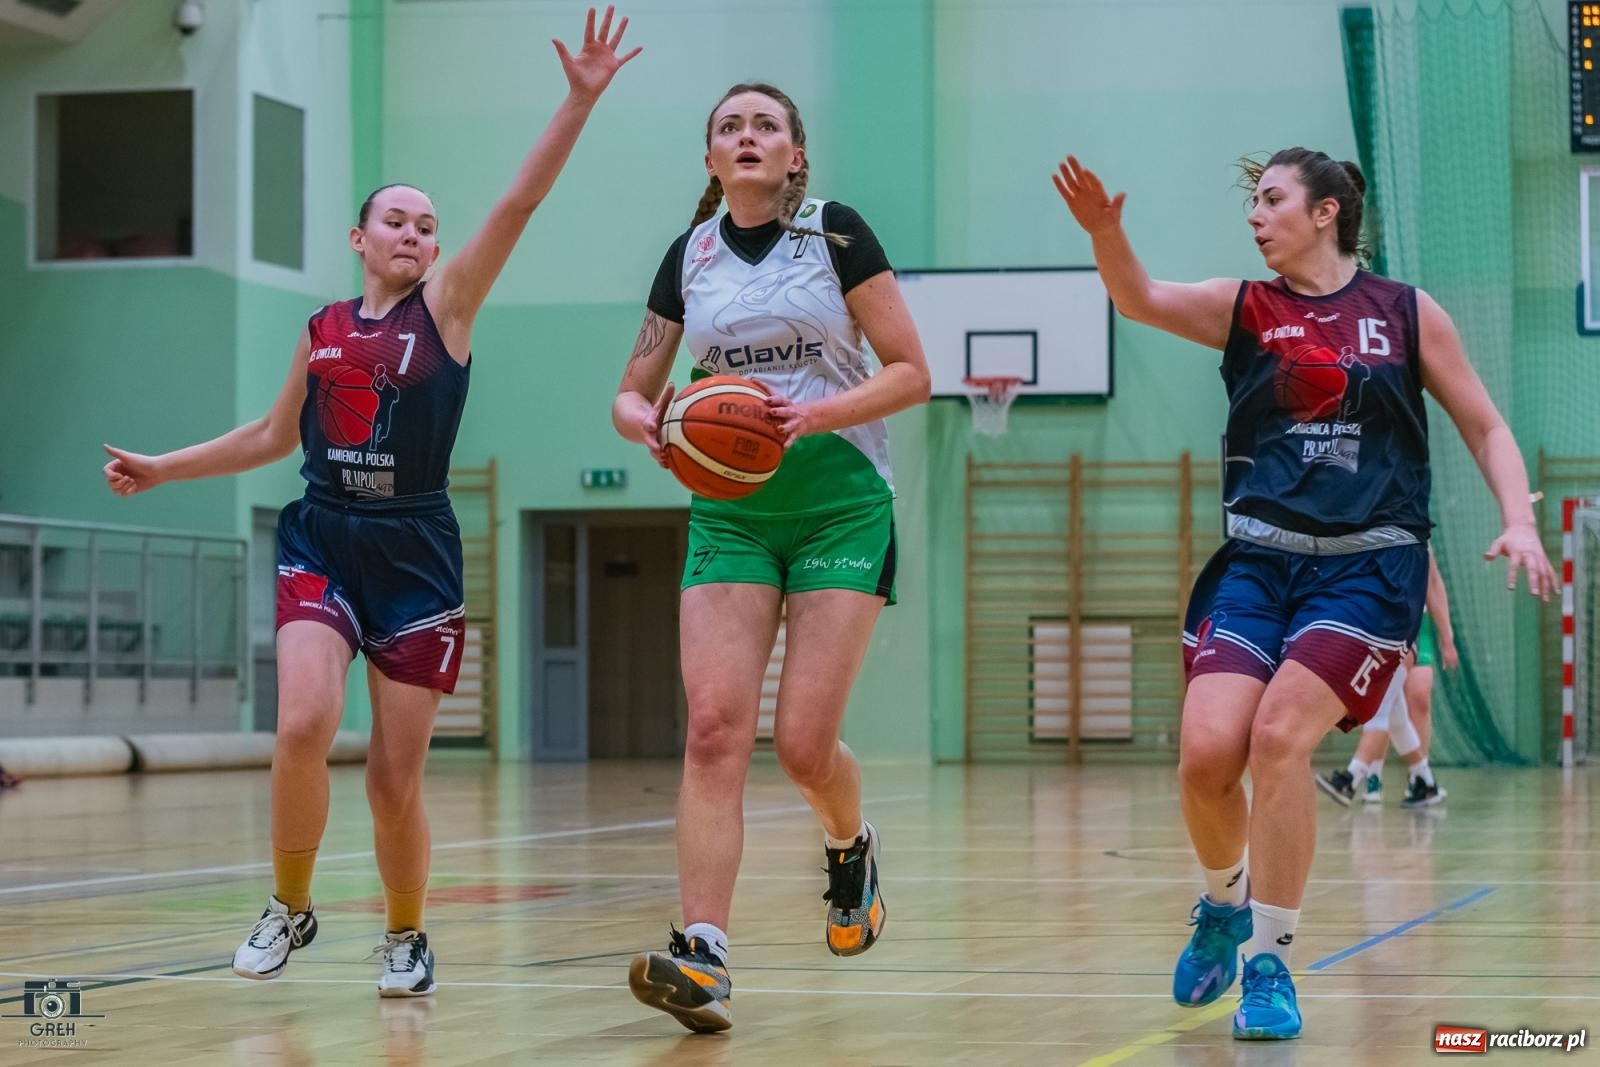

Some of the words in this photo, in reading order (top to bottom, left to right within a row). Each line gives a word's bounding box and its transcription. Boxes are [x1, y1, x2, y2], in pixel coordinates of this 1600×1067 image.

[398, 332, 416, 375] 7
[724, 337, 823, 368] Clavis
[1358, 317, 1391, 356] 15
[327, 447, 363, 465] KAMIENICA
[366, 452, 395, 467] POLSKA
[692, 545, 720, 576] 7
[439, 635, 455, 673] 7
